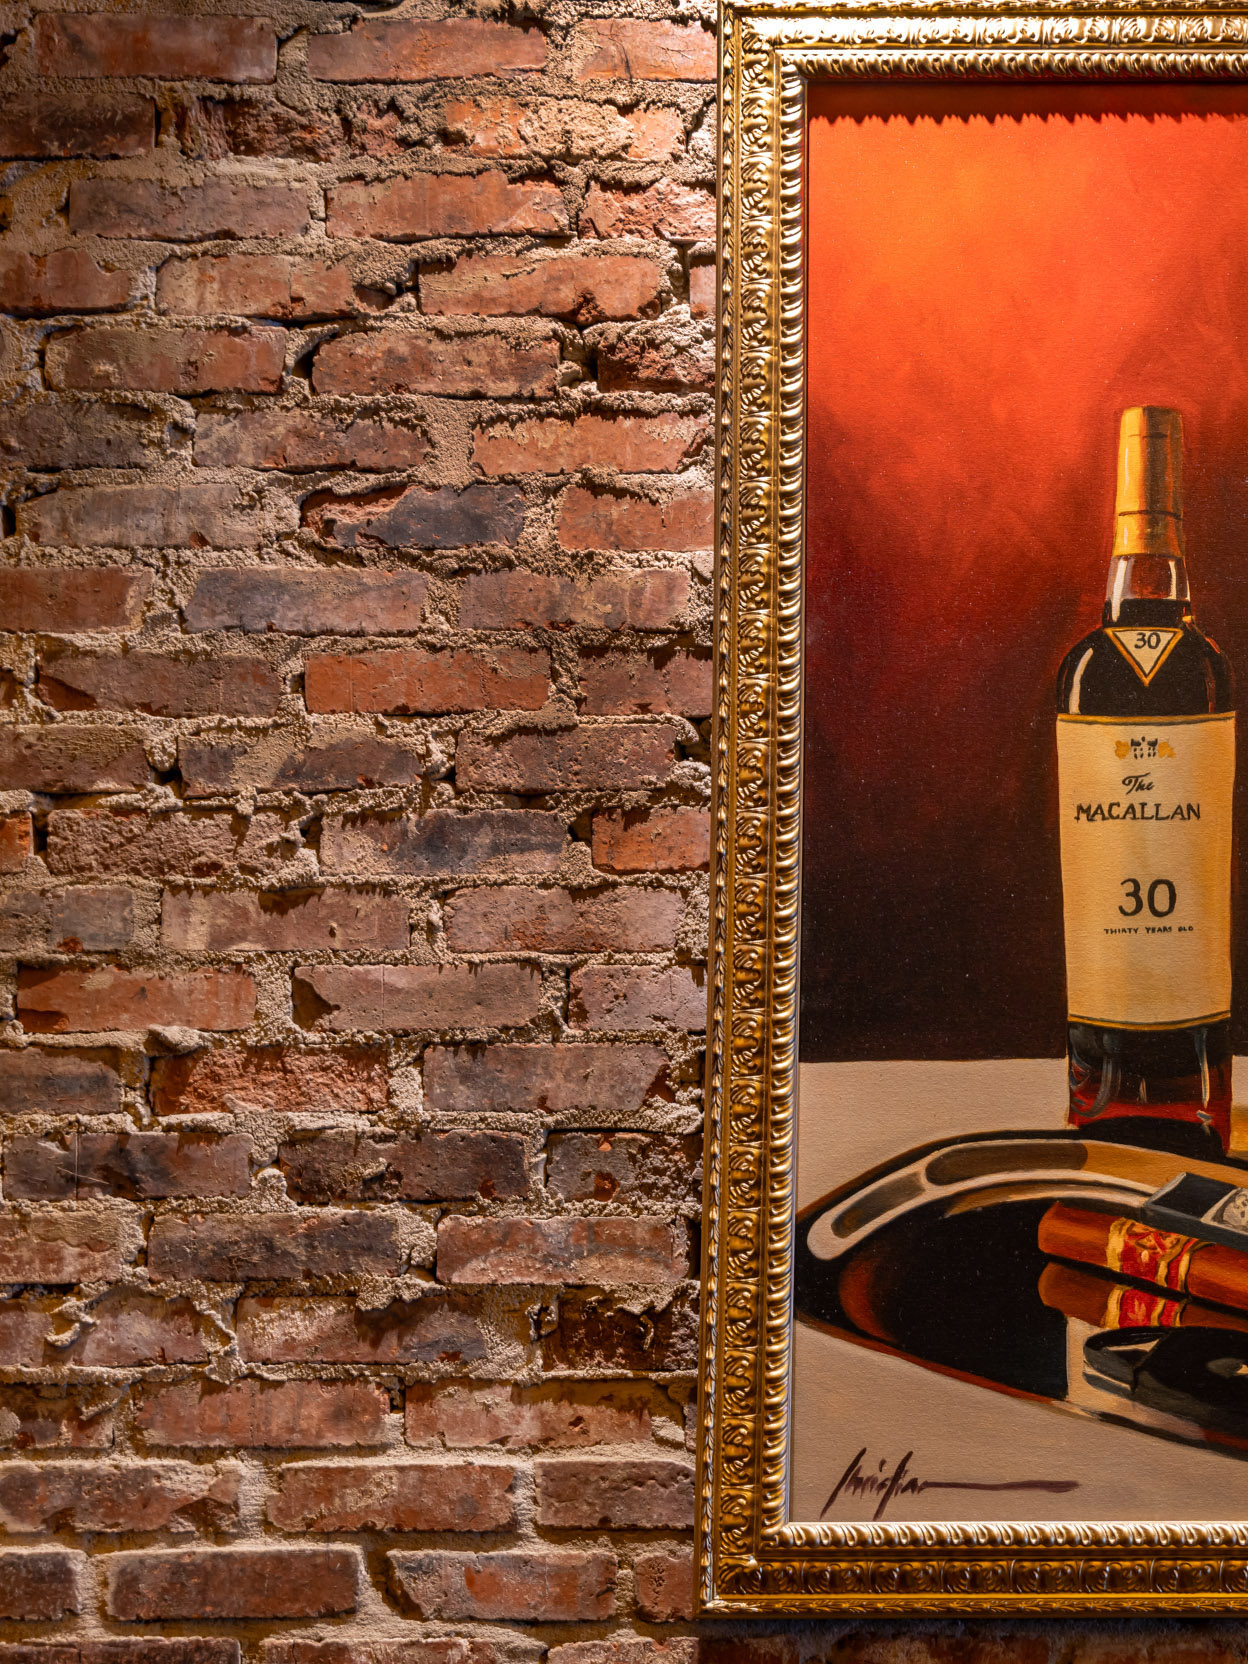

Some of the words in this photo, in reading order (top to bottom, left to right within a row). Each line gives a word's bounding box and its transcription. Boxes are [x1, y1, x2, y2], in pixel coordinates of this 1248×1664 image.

[1134, 633, 1161, 650] 30
[1122, 773, 1154, 795] The
[1074, 802, 1200, 822] MACALLAN
[1118, 878, 1177, 918] 30
[1103, 927, 1139, 935] THIRTY
[1145, 926, 1172, 934] YEARS
